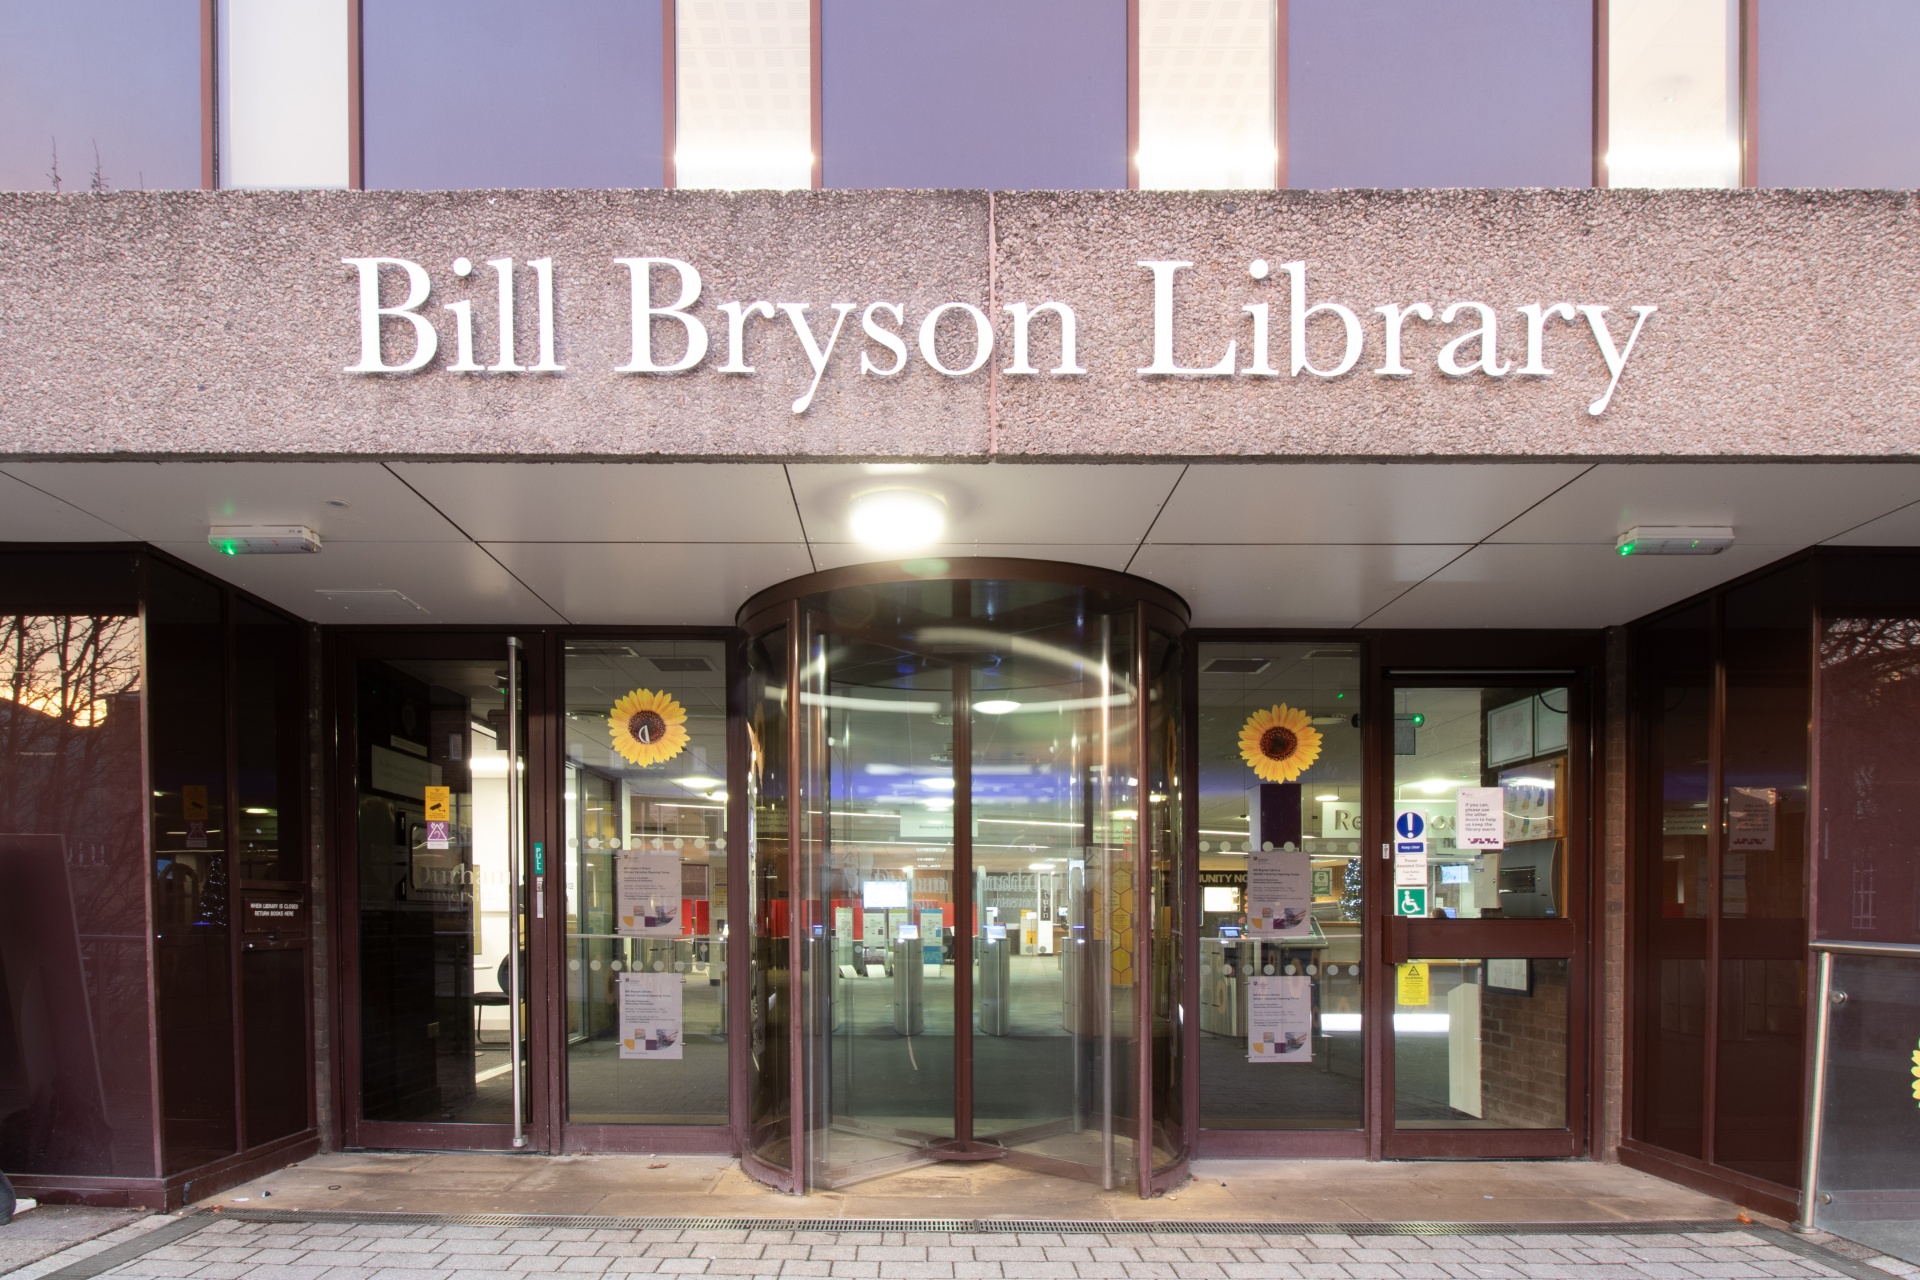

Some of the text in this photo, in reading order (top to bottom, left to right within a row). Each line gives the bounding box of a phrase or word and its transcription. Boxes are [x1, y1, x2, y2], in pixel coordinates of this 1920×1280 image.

[342, 257, 1658, 416] Bill Bryson Library
[1199, 874, 1233, 883] UNITY
